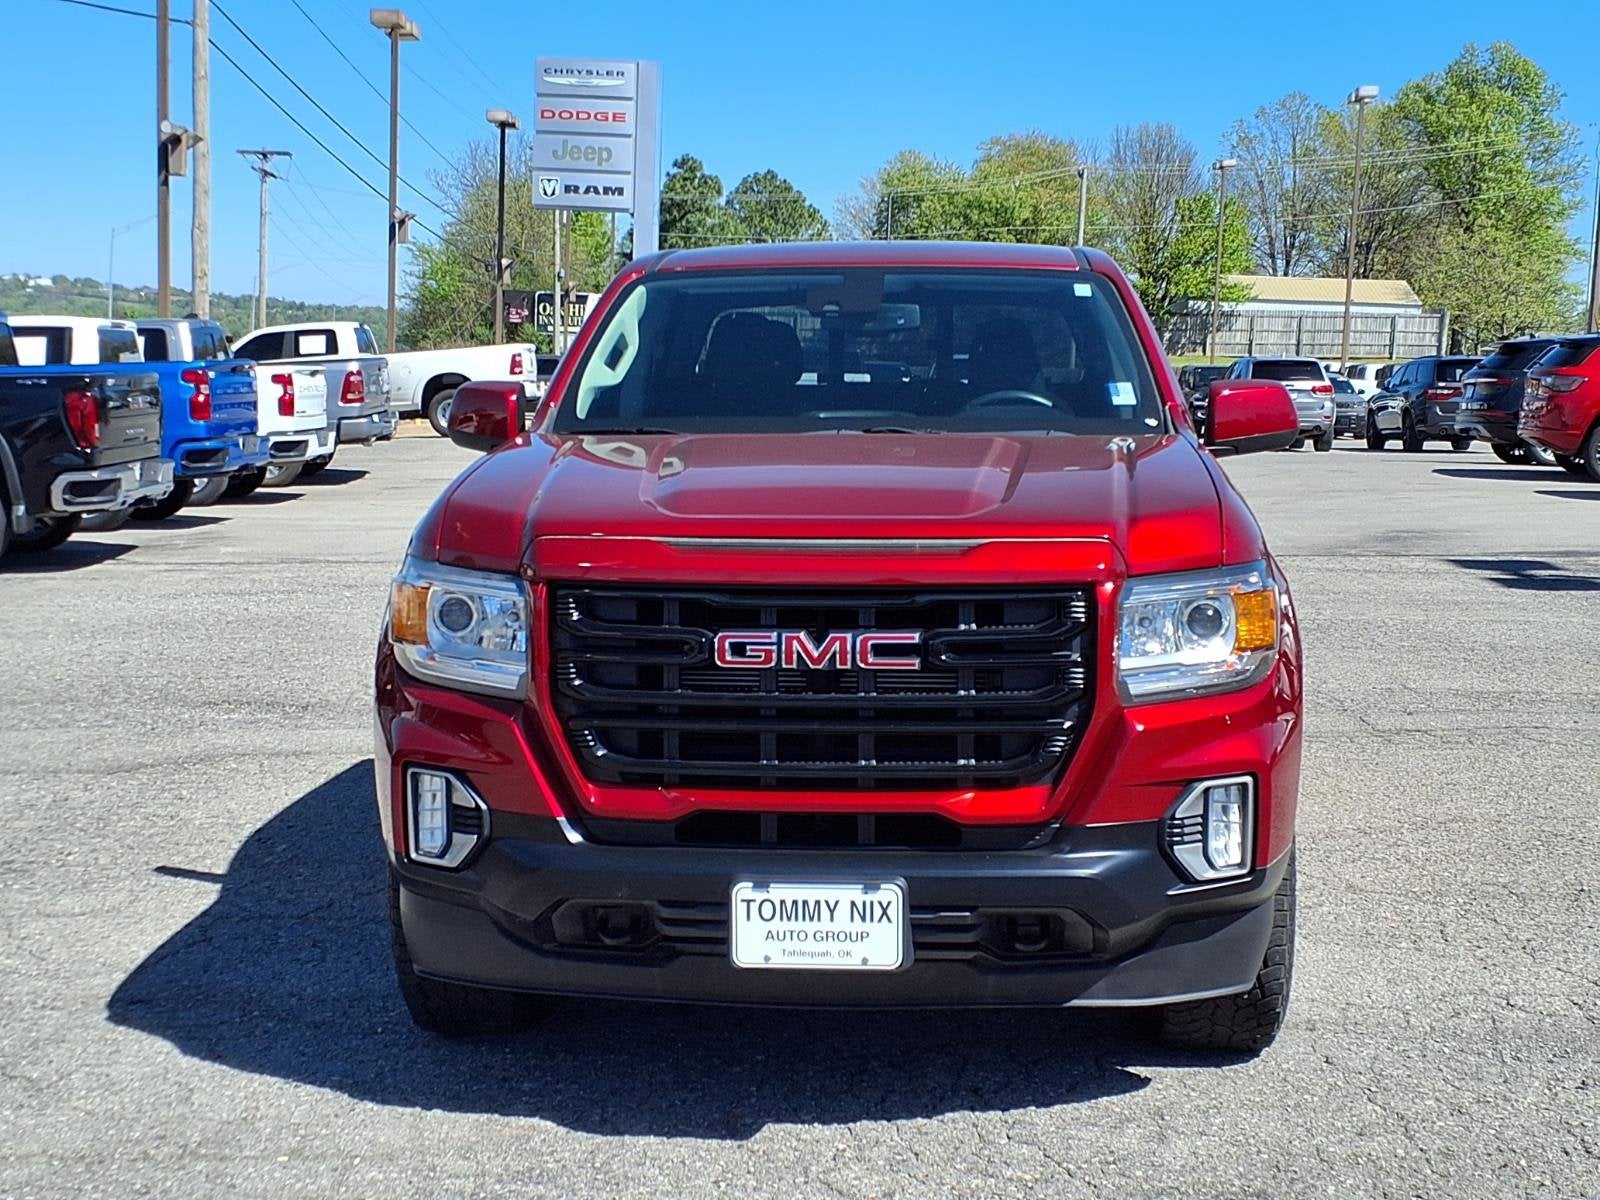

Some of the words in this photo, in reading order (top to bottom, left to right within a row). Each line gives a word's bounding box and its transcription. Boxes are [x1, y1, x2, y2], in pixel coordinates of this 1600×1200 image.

[543, 67, 625, 77] CHRYSLER
[540, 109, 627, 123] DODGE
[552, 139, 613, 167] Jeep
[564, 184, 625, 197] RAM
[714, 631, 922, 669] GMC
[741, 898, 840, 923] TOMMY
[850, 900, 893, 924] NIX
[765, 930, 808, 942] AUTO
[813, 930, 870, 943] GROUP
[782, 948, 834, 959] Tahlequah,
[837, 948, 853, 959] OK
